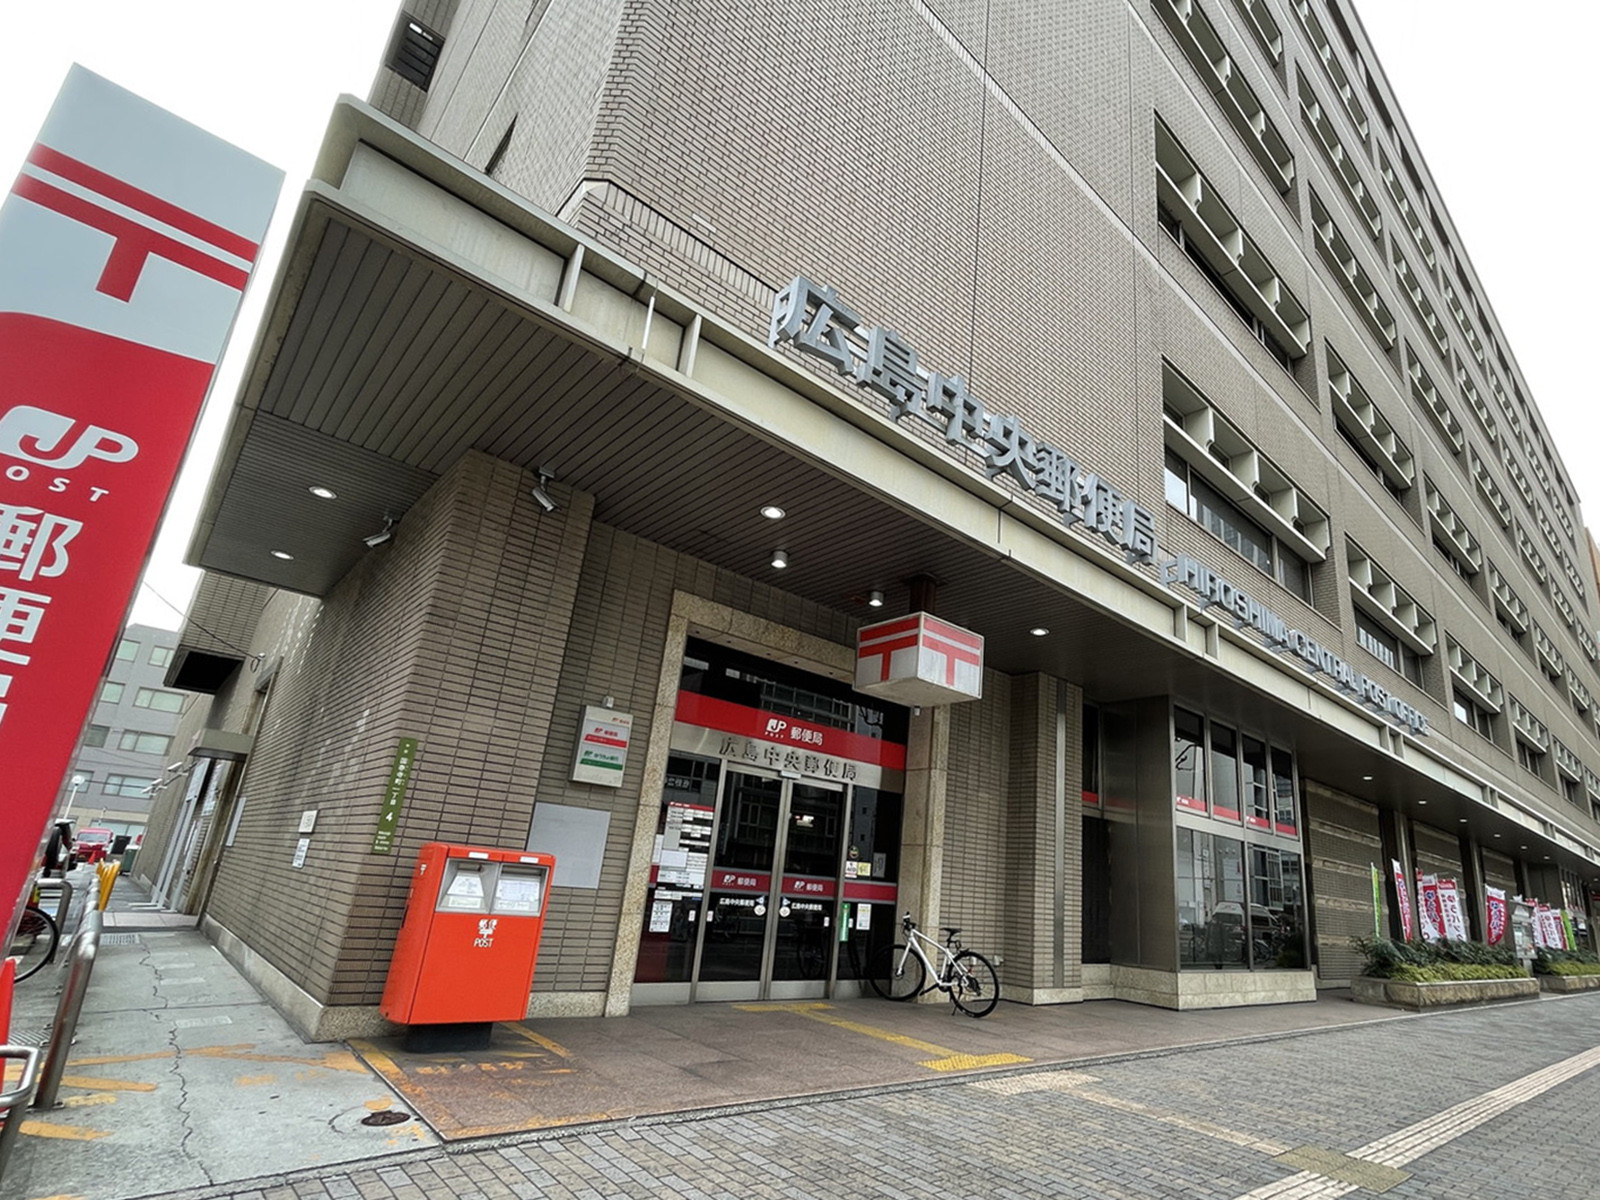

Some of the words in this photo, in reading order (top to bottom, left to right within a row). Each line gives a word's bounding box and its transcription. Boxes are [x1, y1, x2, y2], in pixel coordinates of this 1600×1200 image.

[0, 405, 139, 470] JP
[770, 275, 1158, 564] 広島中央郵便局
[5, 465, 109, 502] OST
[1177, 552, 1290, 648] HIROSHIMA
[1289, 630, 1359, 692] CENTRAL
[1357, 674, 1391, 709] POST
[1389, 697, 1430, 736] OFFICE
[719, 736, 858, 782] 広島中央郵便局
[790, 726, 824, 746] 郵便局
[474, 937, 494, 948] POST
